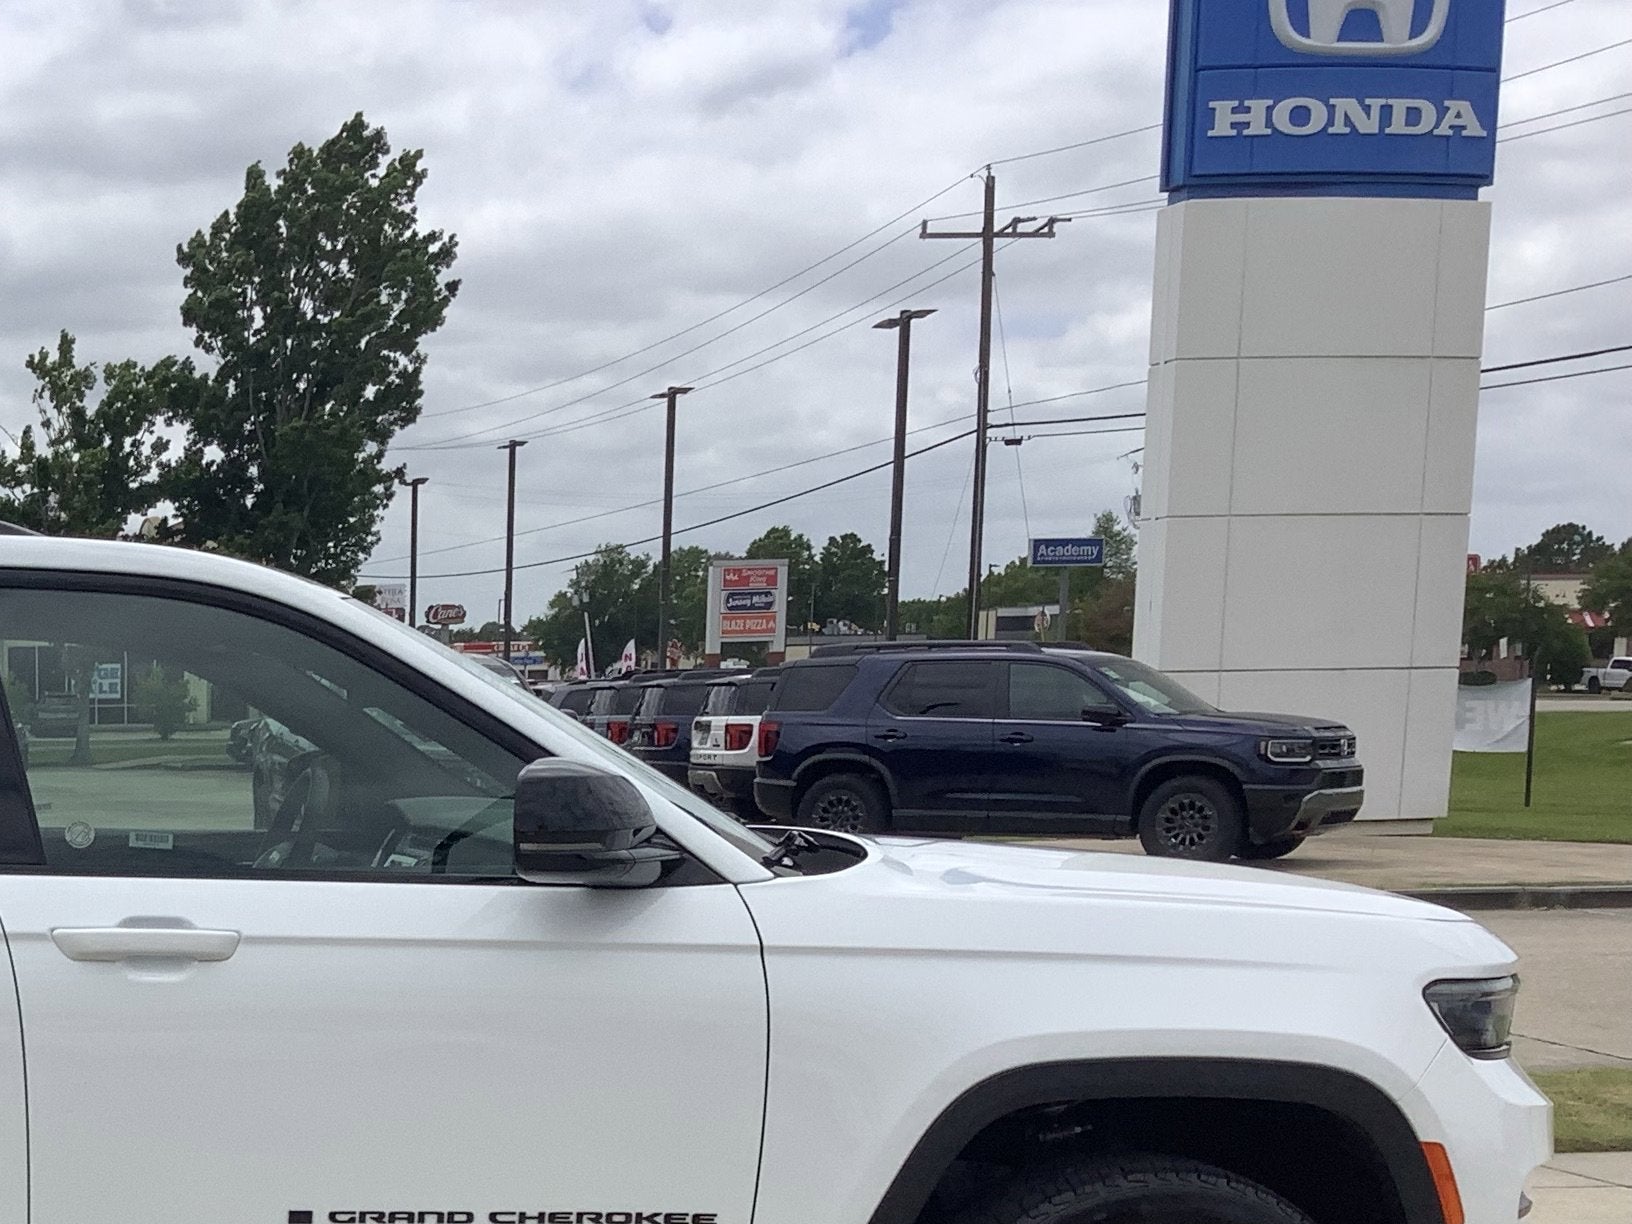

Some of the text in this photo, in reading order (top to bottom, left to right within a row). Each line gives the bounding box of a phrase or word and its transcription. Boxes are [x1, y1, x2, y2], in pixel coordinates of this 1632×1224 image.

[1206, 97, 1488, 137] HONDA
[1037, 544, 1100, 559] Academy
[722, 620, 745, 630] BLAZE
[746, 619, 767, 629] PIZZA
[328, 1211, 474, 1224] GRAND
